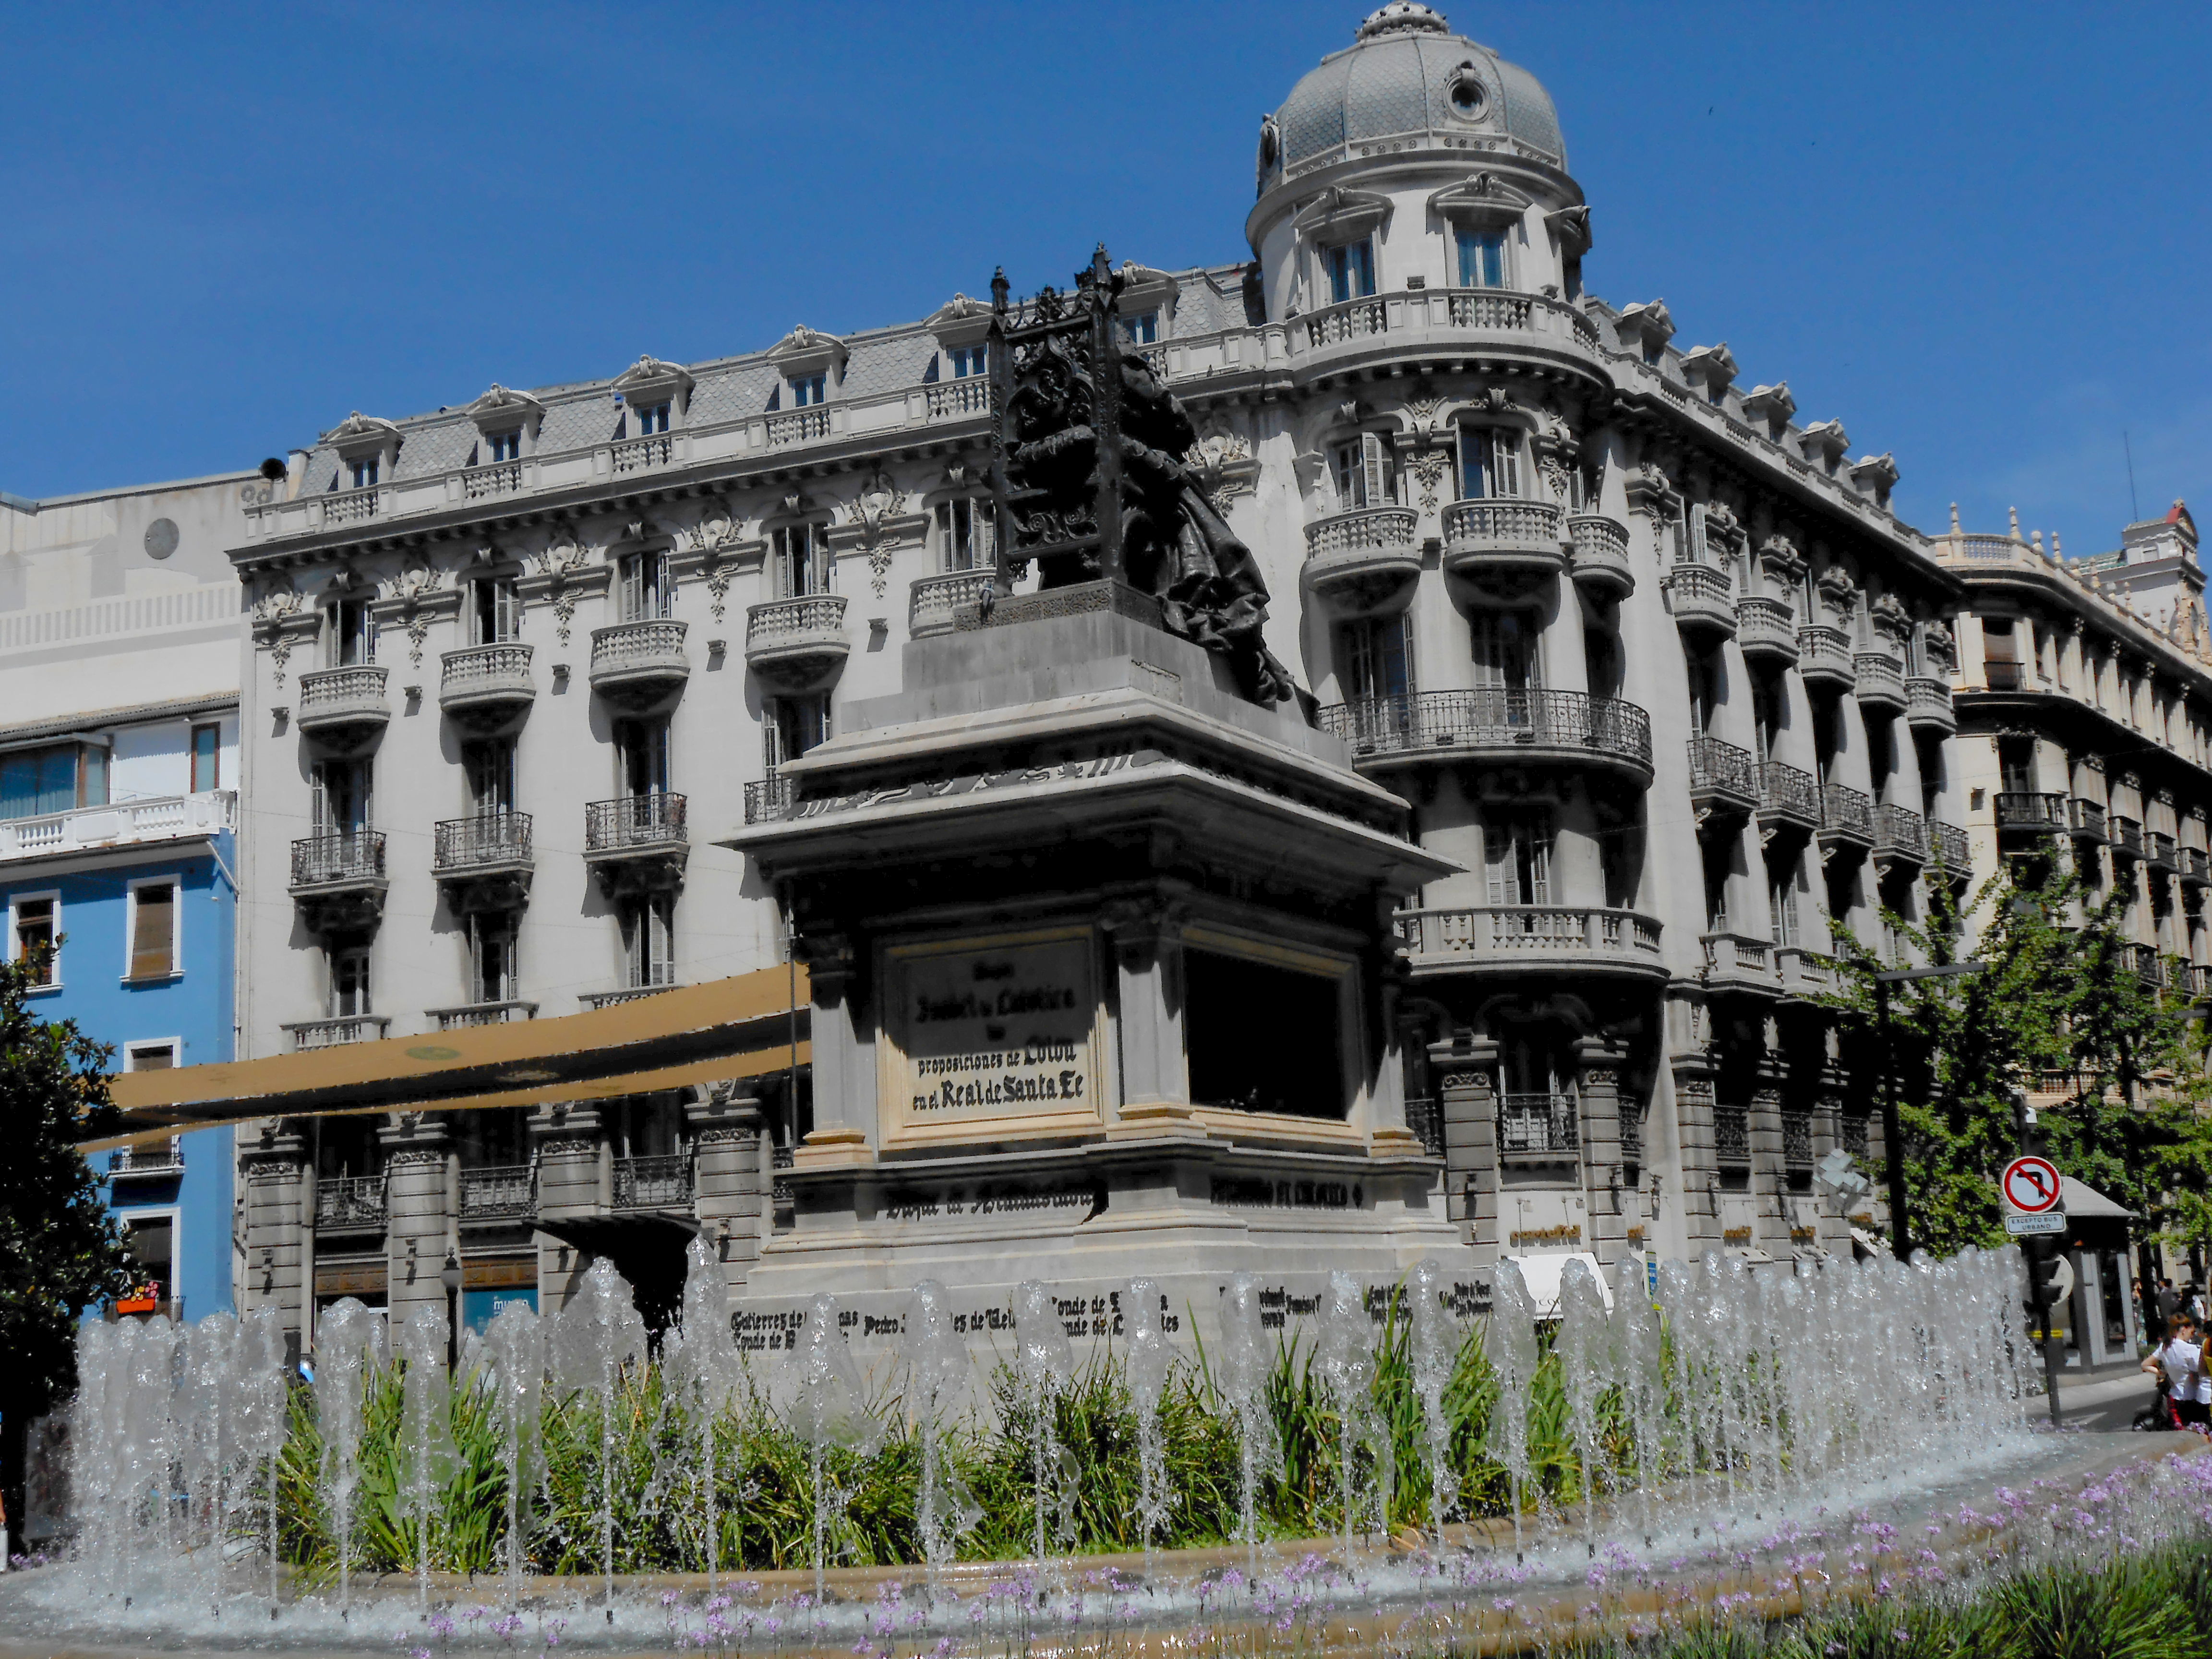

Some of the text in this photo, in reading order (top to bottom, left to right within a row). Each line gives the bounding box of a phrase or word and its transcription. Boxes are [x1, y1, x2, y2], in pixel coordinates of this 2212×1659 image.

[918, 1053, 1002, 1078] proposiciones
[1007, 1047, 1020, 1068] de
[913, 1095, 927, 1110] en
[929, 1090, 938, 1109] el
[941, 1080, 984, 1107] Real
[986, 1080, 1002, 1105] de
[1003, 1075, 1058, 1103] Santa
[1052, 1297, 1086, 1316] onde
[971, 1310, 984, 1331] de
